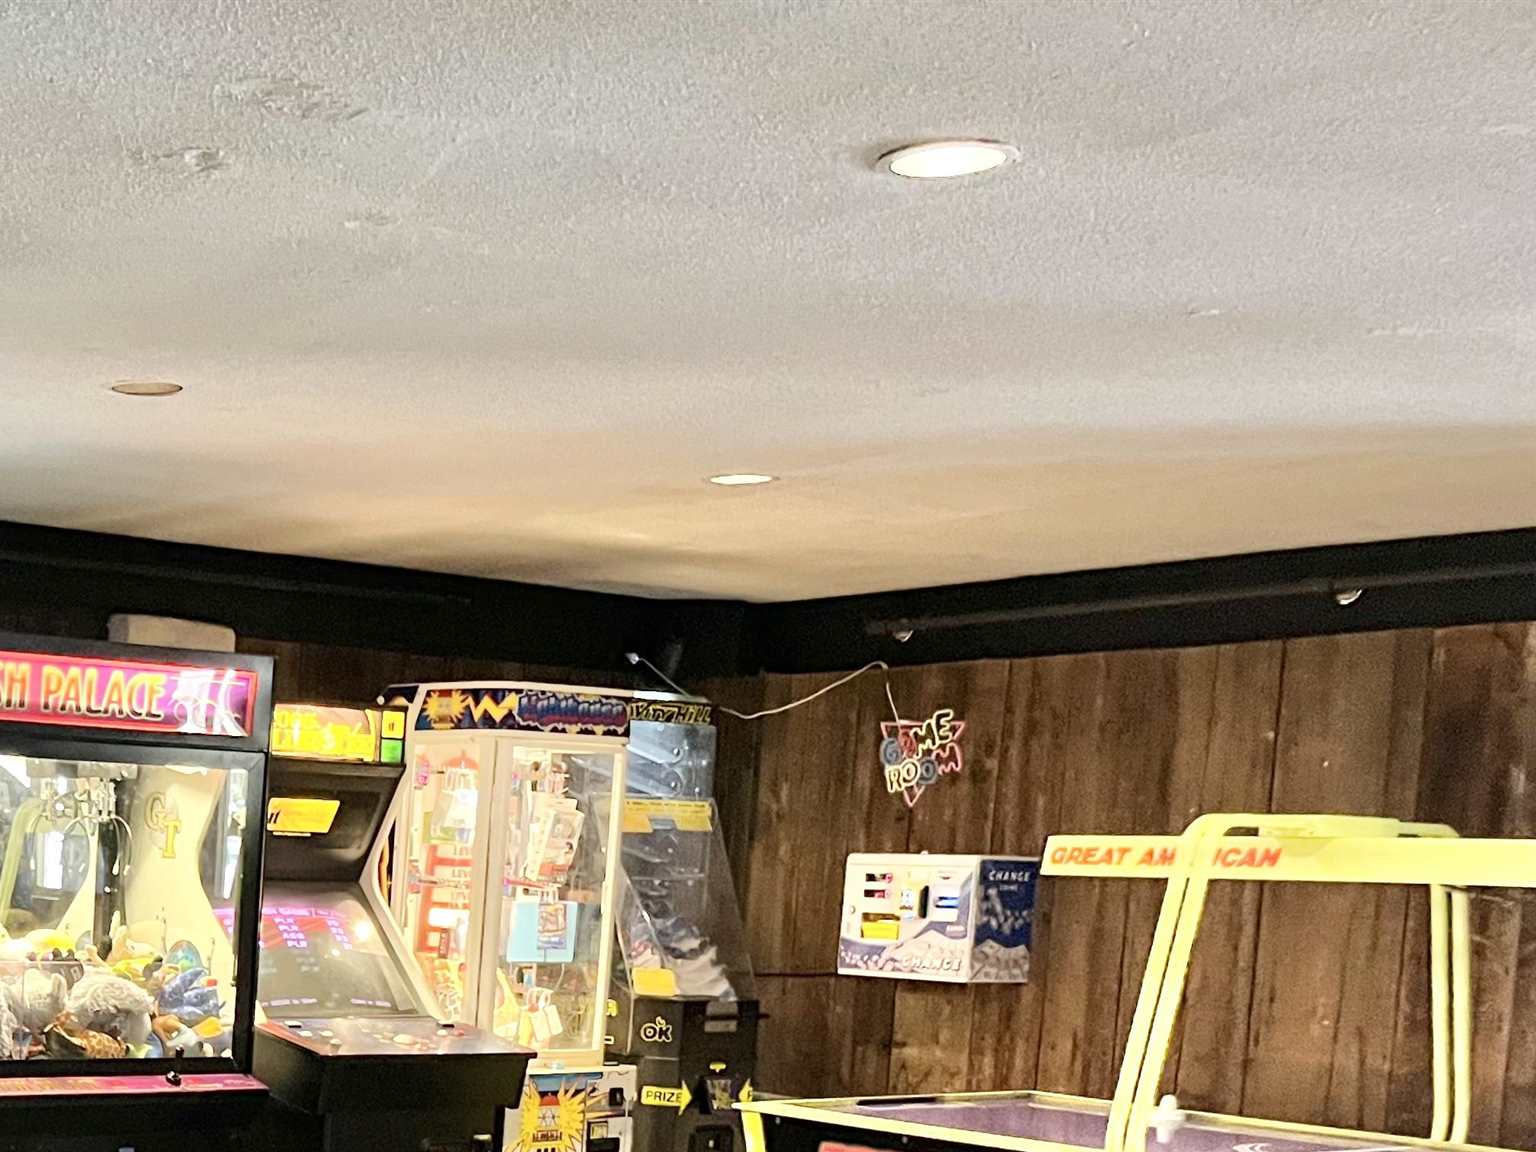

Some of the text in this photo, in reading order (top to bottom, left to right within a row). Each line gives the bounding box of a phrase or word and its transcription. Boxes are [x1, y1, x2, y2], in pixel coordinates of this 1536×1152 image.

[41, 665, 168, 720] PALACE
[880, 709, 954, 767] GAME
[885, 742, 962, 794] ROOM
[1051, 846, 1282, 868] GREAT AMICAN
[988, 870, 1031, 882] CHANGE
[901, 955, 962, 972] CHANGE
[640, 1022, 672, 1042] OK
[645, 1090, 683, 1104] PRIZE
